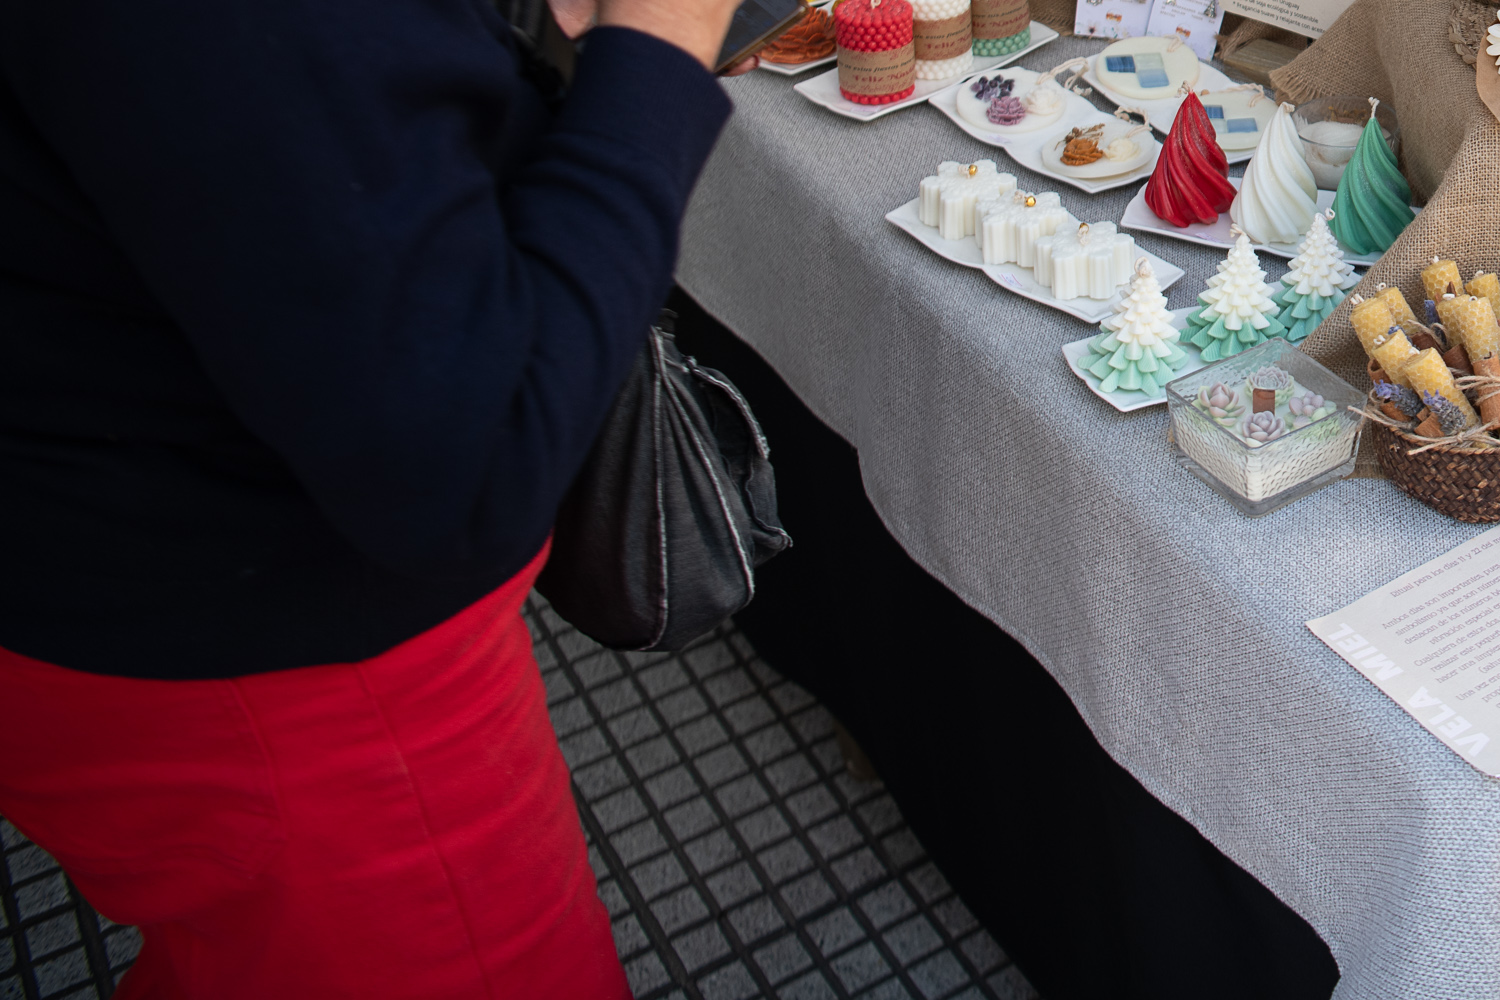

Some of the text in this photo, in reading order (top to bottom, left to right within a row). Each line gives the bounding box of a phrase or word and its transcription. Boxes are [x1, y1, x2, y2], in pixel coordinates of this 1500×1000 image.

[1279, 0, 1300, 10] Uruguay
[1390, 583, 1414, 598] Ritual
[1413, 575, 1433, 587] para
[1430, 568, 1444, 577] los
[1443, 560, 1460, 570] días
[1471, 547, 1482, 555] 22
[1481, 542, 1493, 550] del
[1382, 614, 1409, 629] Ambos
[1409, 605, 1425, 615] días
[1424, 597, 1440, 607] son
[1483, 564, 1500, 576] pues
[1395, 612, 1437, 636] simbolismo
[1437, 606, 1449, 614] ya
[1448, 598, 1464, 607] que
[1463, 590, 1478, 600] son
[1404, 625, 1438, 644] destacan
[1438, 619, 1449, 627] de
[1447, 613, 1461, 621] los
[1460, 595, 1493, 614] números
[1429, 624, 1465, 645] vibración
[1465, 608, 1494, 625] especial
[1329, 624, 1488, 755] VELA MIEL
